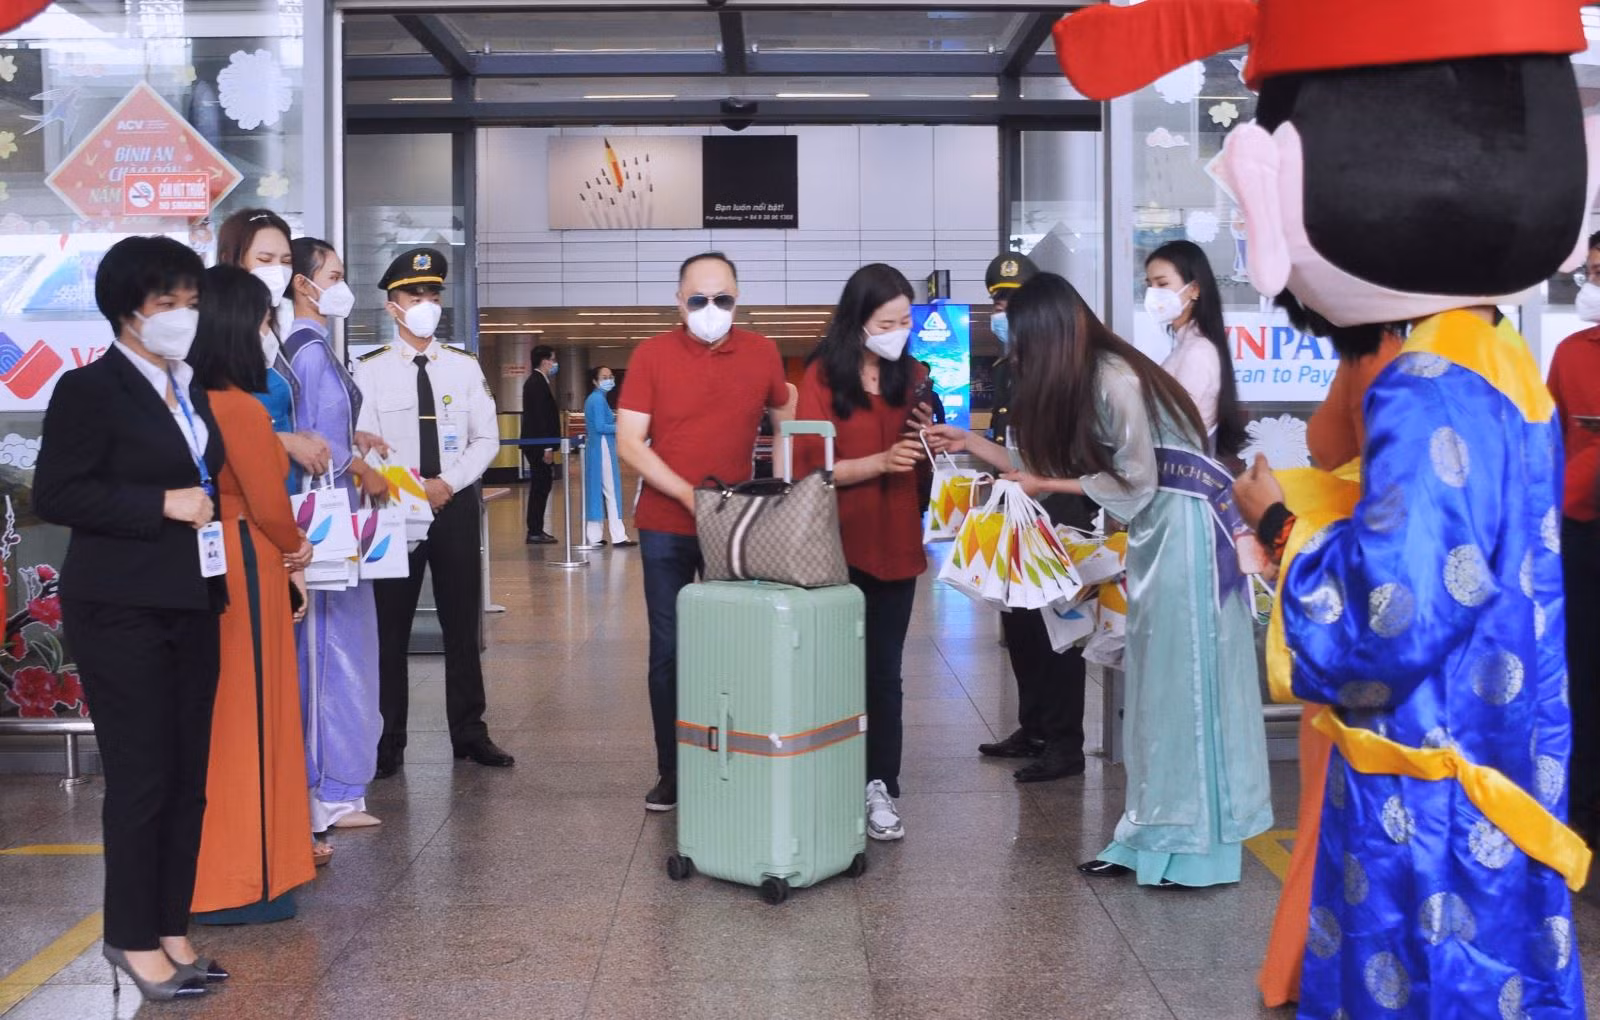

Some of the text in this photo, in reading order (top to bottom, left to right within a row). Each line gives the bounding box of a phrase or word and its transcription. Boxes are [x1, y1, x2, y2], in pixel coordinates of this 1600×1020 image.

[116, 120, 144, 130] ACV
[115, 145, 175, 162] BÌNH AN
[1224, 326, 1341, 361] NPA
[1233, 365, 1336, 388] can to Pay
